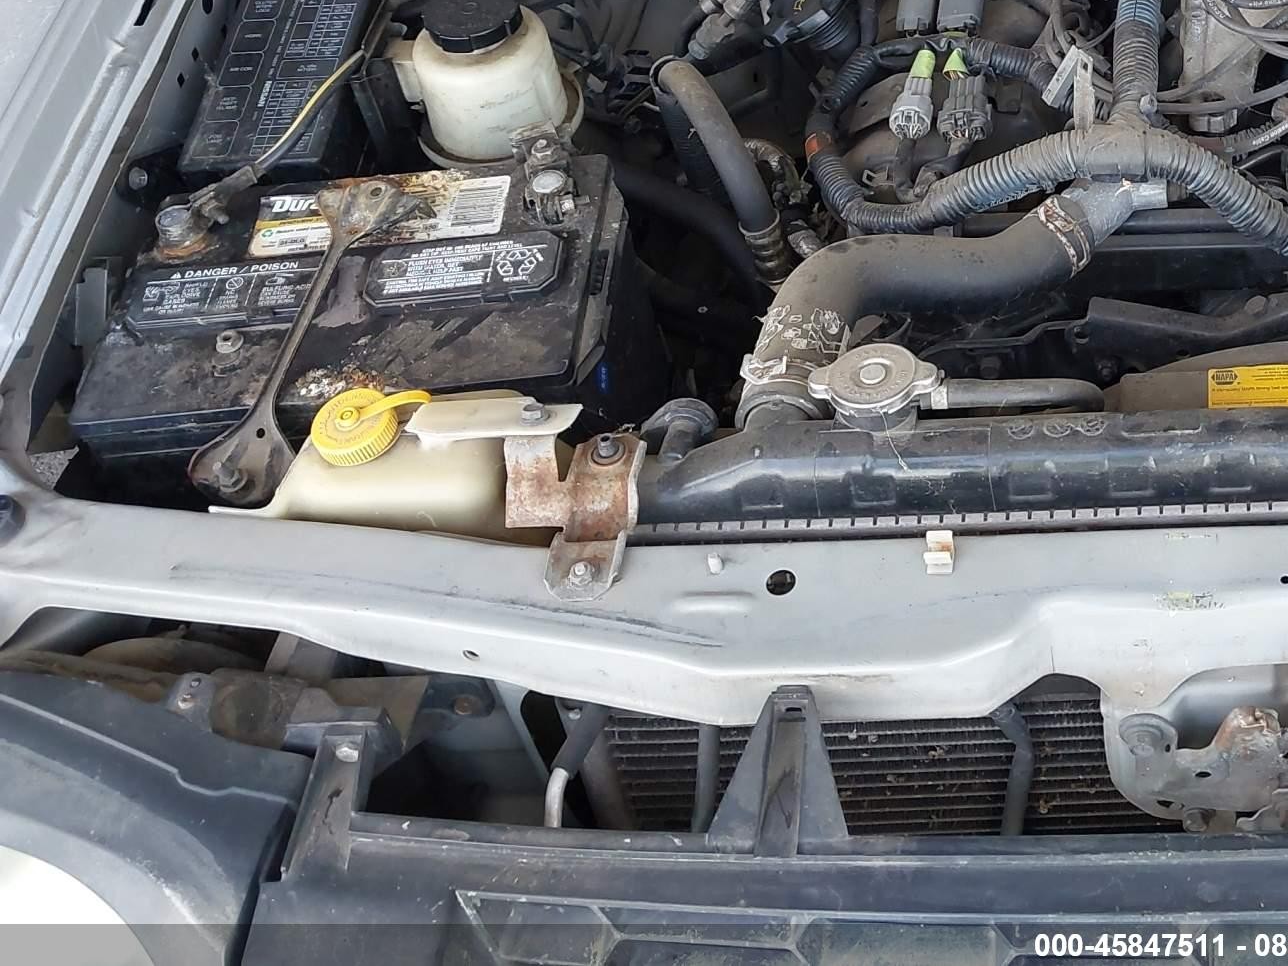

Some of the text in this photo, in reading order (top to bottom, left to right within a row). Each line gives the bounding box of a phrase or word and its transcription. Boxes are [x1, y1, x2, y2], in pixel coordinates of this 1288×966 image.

[184, 266, 238, 278] DANGER
[250, 261, 300, 273] POISON
[1215, 372, 1236, 383] NAPA
